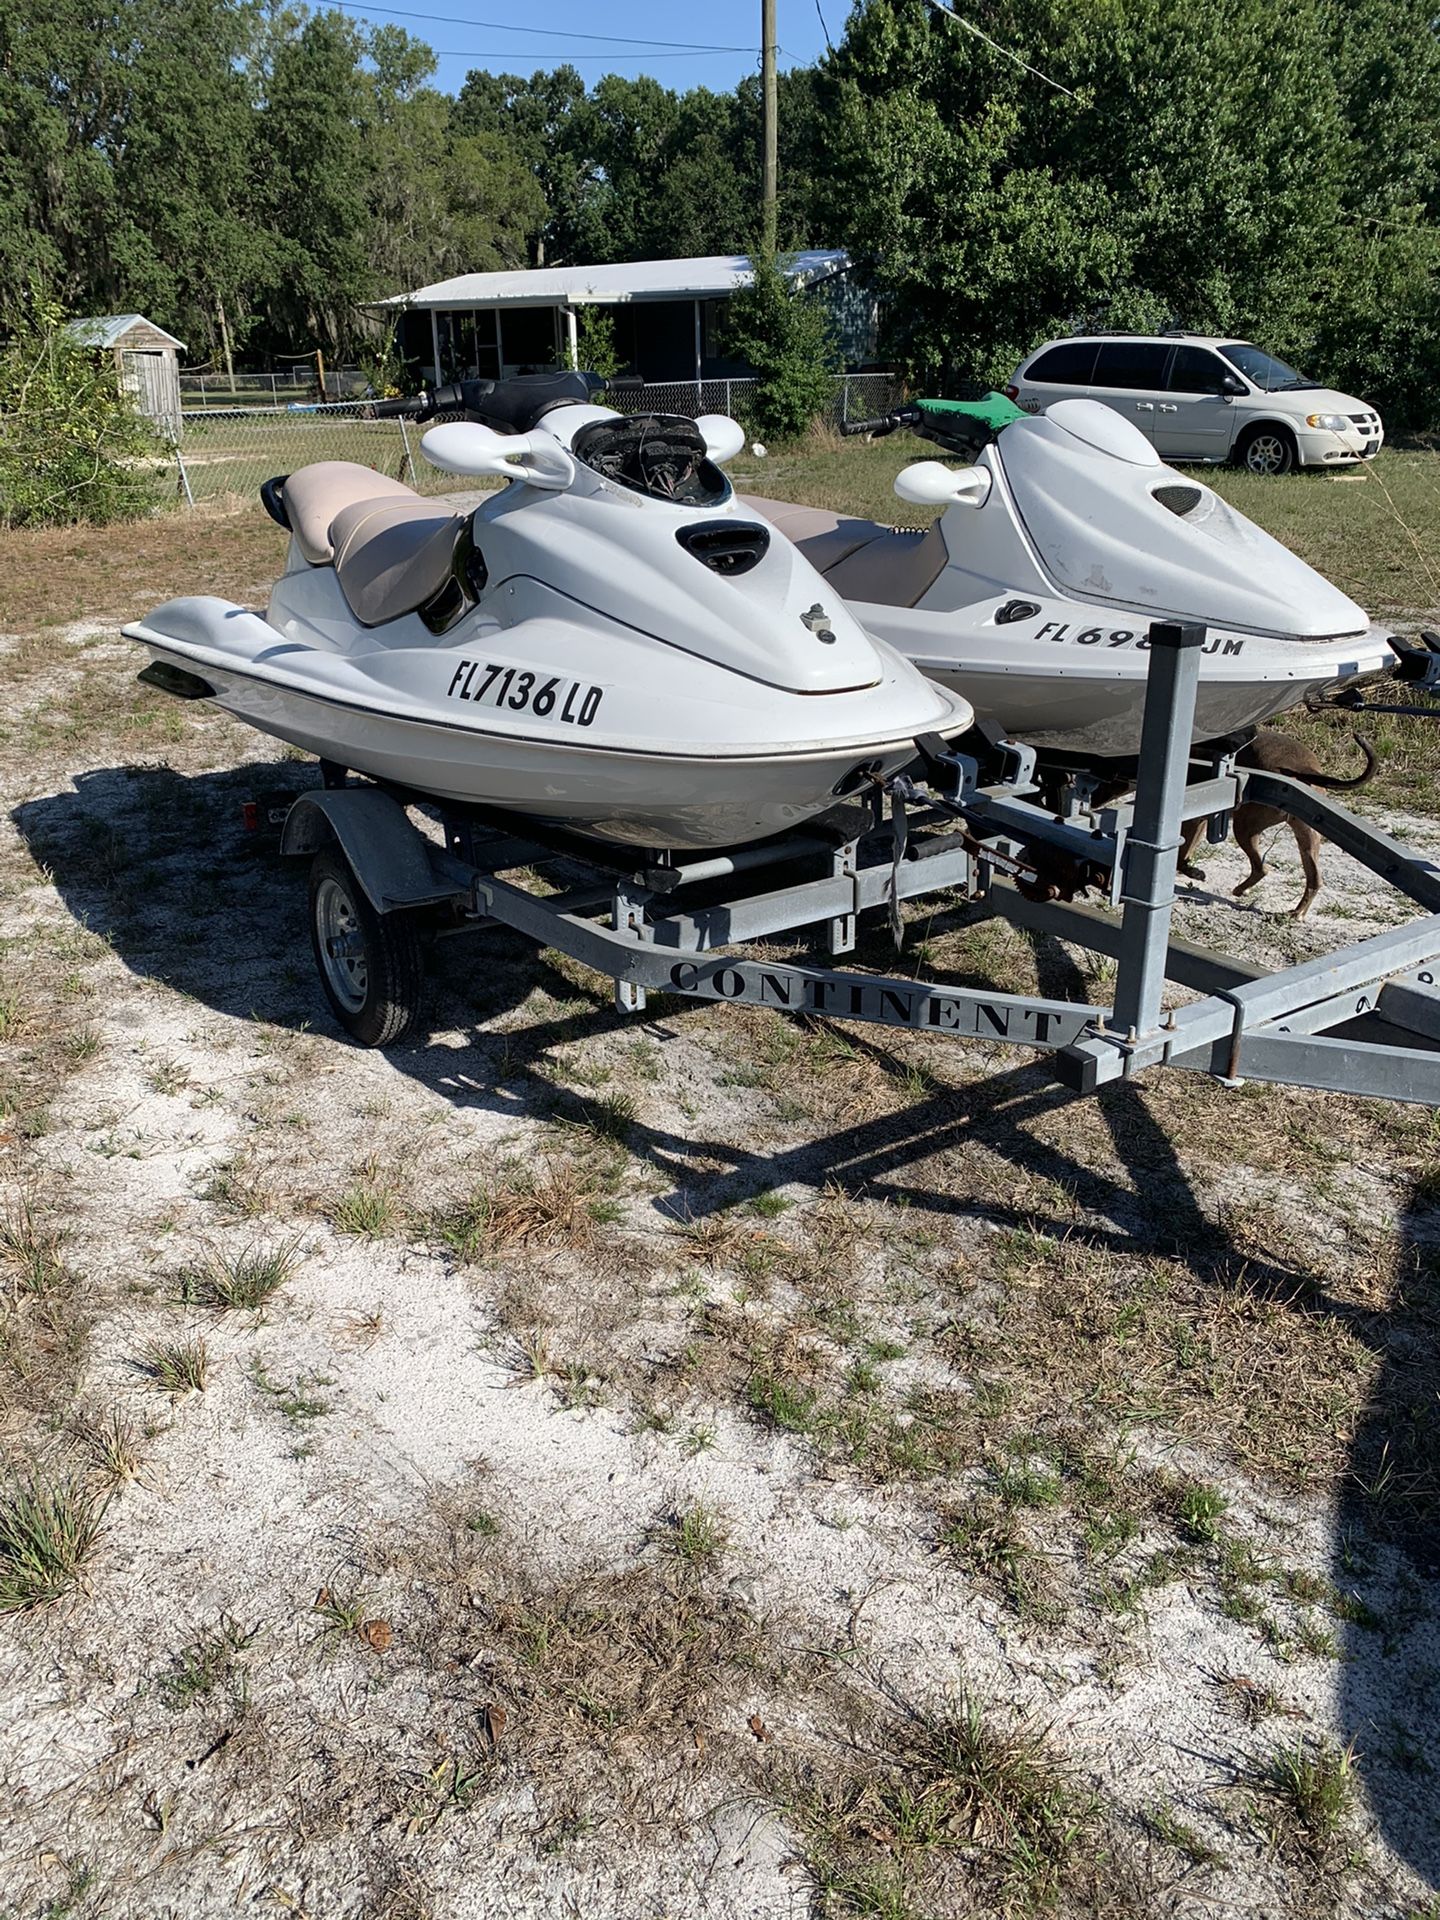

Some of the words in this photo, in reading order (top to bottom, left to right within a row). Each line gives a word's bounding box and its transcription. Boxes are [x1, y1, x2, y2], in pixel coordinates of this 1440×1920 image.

[1033, 622, 1070, 643] FL
[1076, 627, 1150, 650] 698
[1200, 638, 1244, 656] JM
